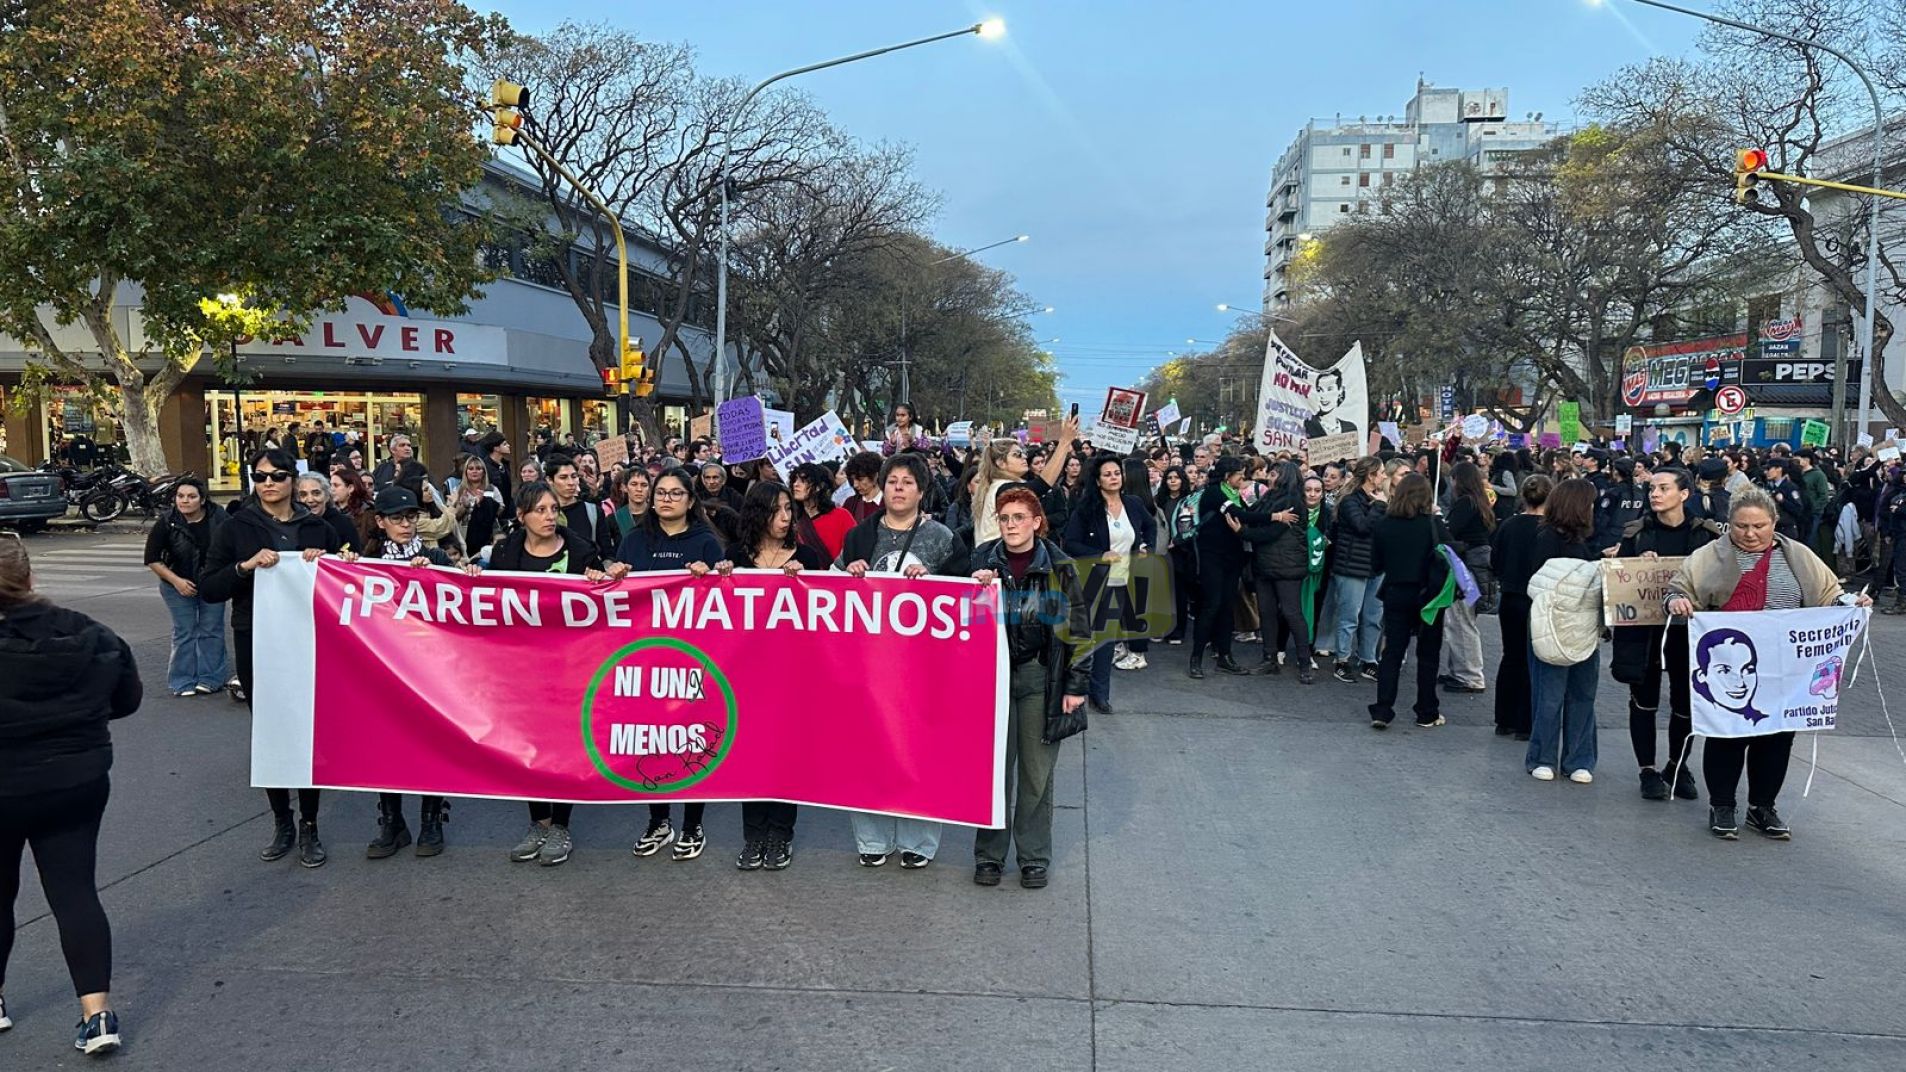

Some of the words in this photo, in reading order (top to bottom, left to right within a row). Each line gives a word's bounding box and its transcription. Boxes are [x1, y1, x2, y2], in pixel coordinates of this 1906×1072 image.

[1262, 430, 1293, 448] SAN
[339, 576, 542, 627] ¡PAREN
[561, 591, 632, 628] DE
[651, 587, 971, 641] MATARNOS!
[1615, 603, 1637, 620] NO
[614, 666, 642, 697] NI
[1783, 706, 1818, 718] Partido
[1806, 717, 1823, 727] San
[610, 723, 707, 756] MENOS
